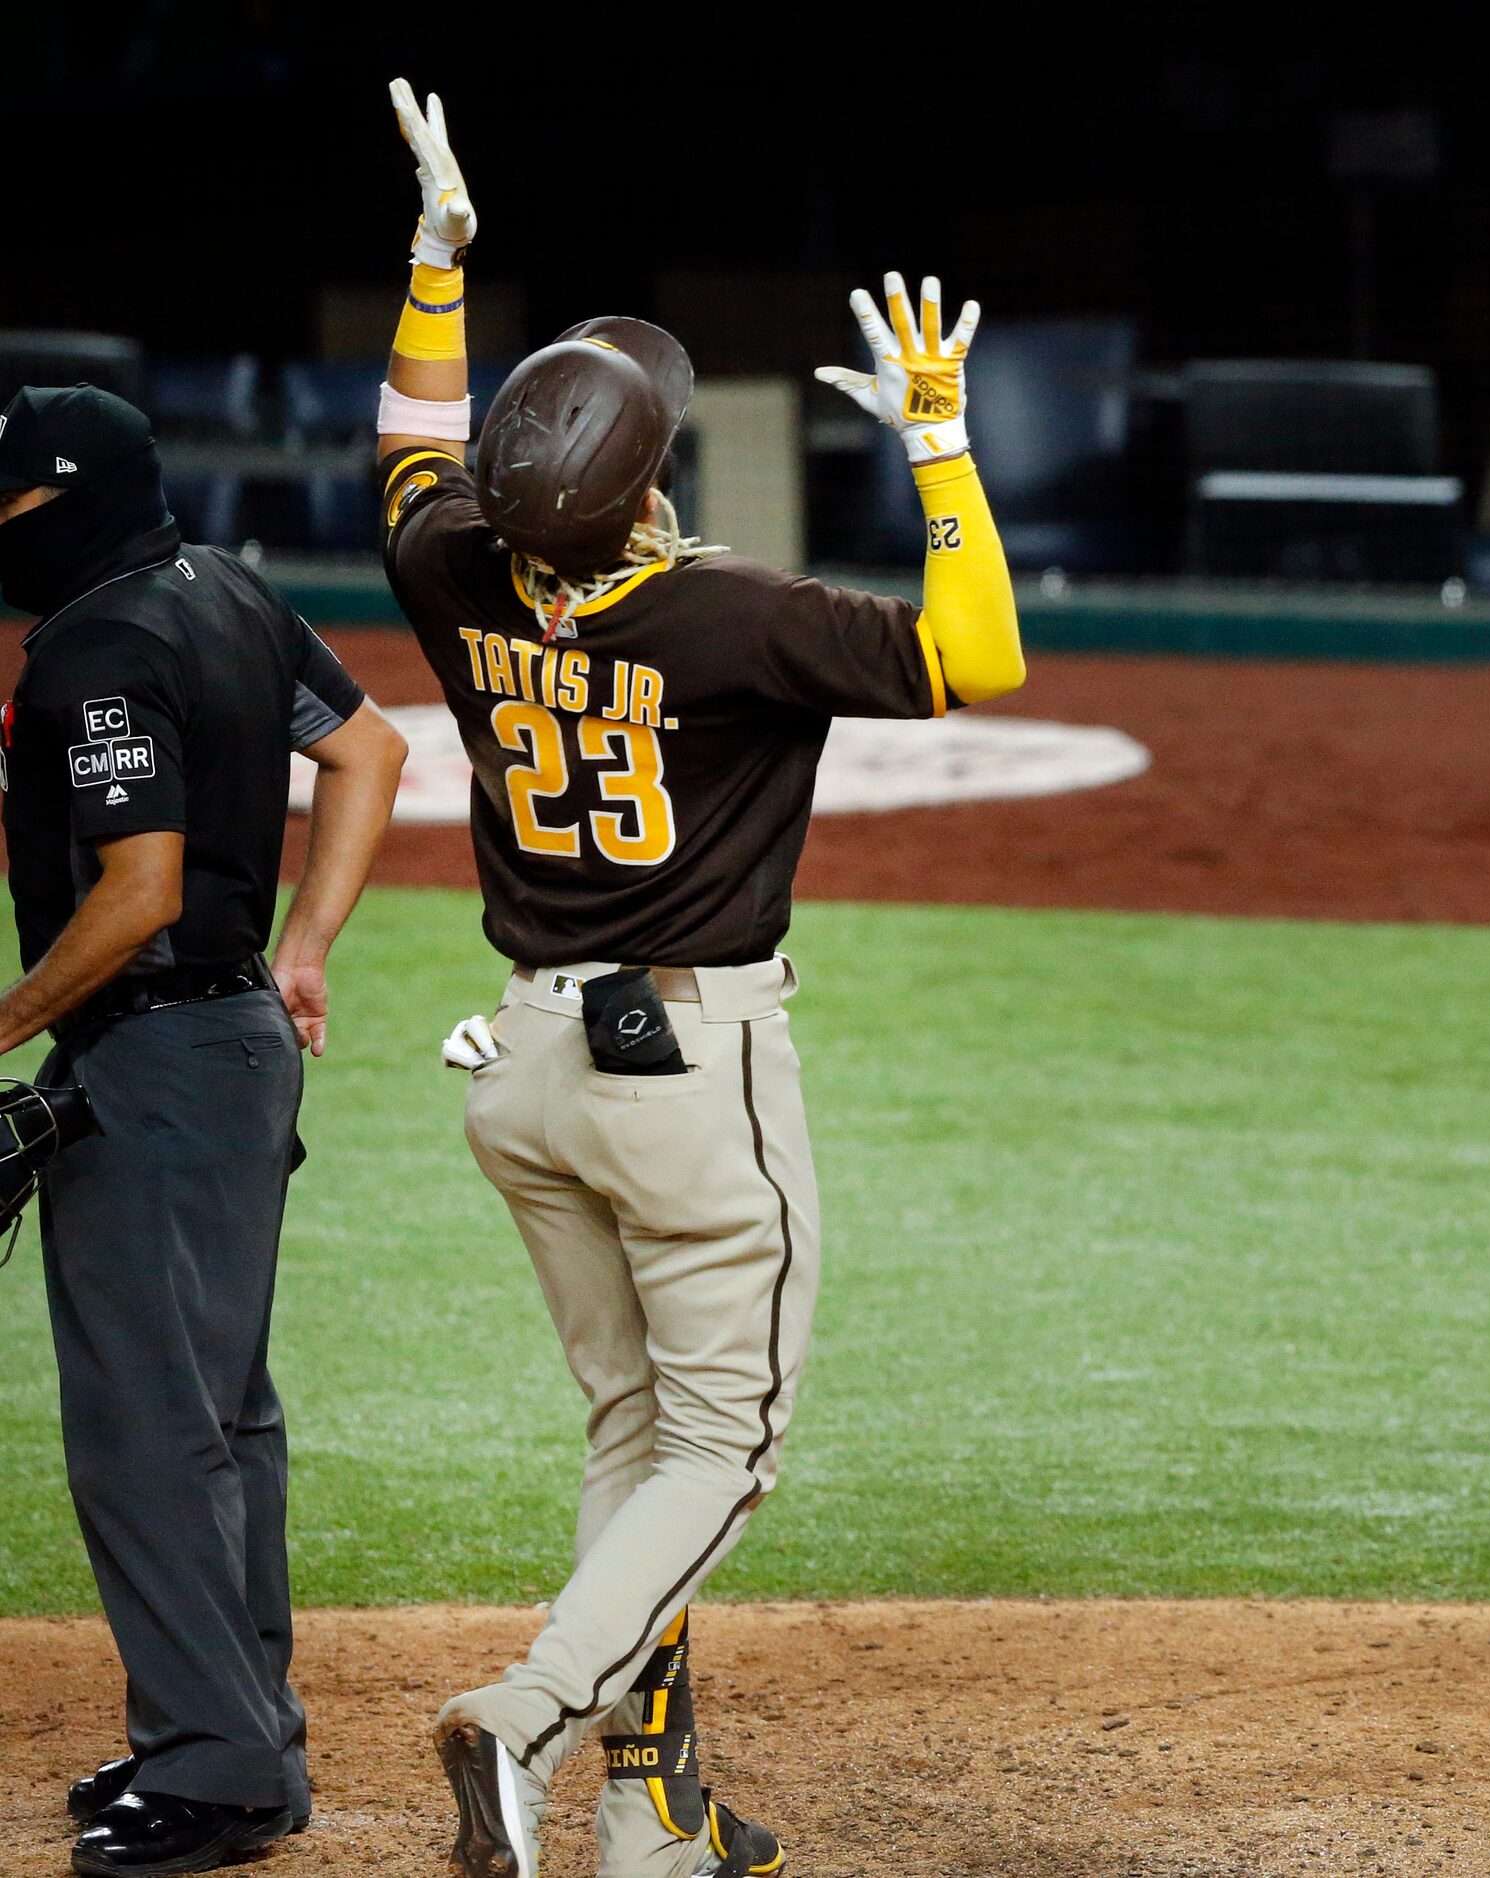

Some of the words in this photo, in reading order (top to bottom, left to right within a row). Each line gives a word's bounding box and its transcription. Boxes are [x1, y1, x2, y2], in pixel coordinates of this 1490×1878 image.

[911, 373, 956, 414] adidas
[927, 516, 963, 551] 23
[458, 626, 591, 713] TATIS
[602, 660, 679, 730] JR.
[87, 708, 125, 732] EC
[74, 752, 109, 775] CM
[115, 746, 150, 770] RR
[490, 700, 677, 866] 23
